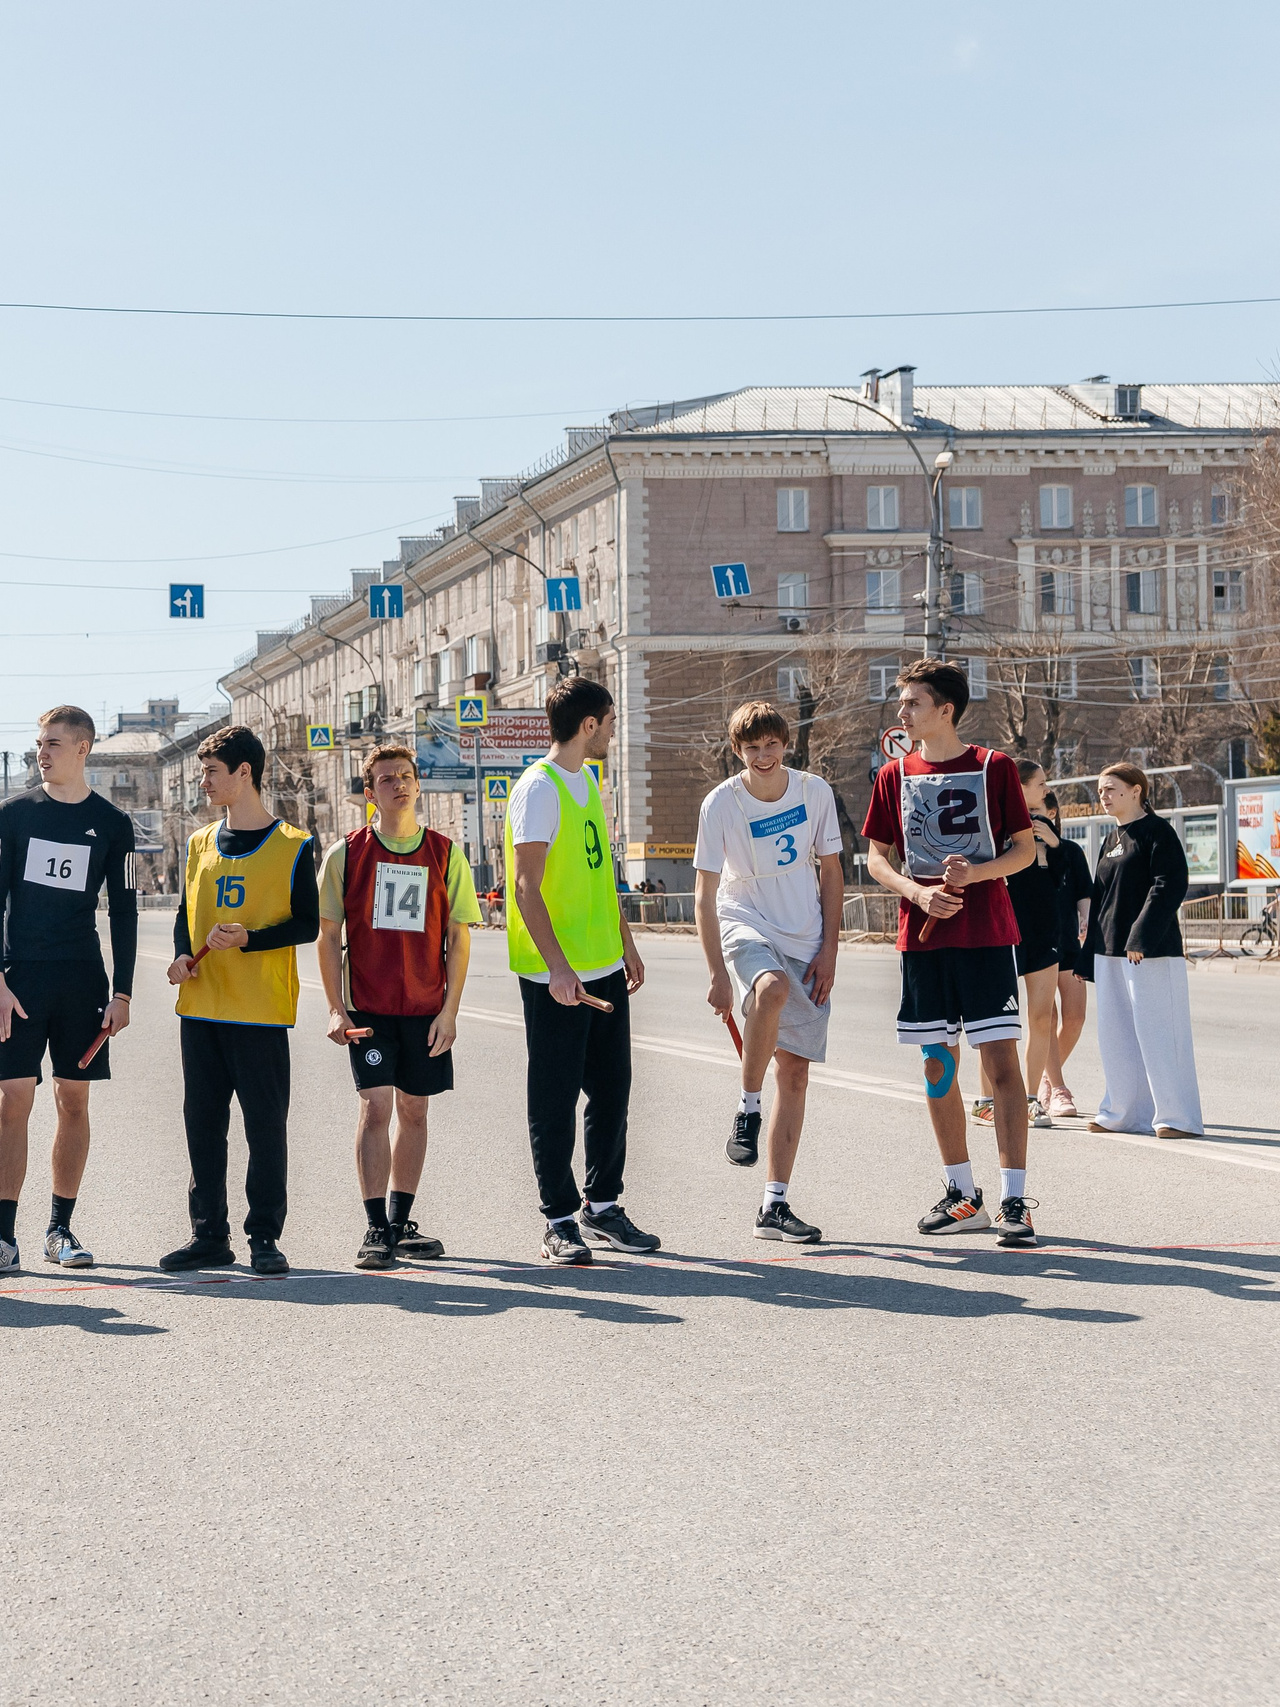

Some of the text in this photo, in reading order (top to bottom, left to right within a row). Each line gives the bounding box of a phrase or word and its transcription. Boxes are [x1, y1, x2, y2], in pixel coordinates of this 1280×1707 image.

[760, 810, 800, 829] ИНЖЕНЕРНЫЙ
[937, 789, 981, 836] 2
[584, 819, 604, 870] 9
[764, 823, 785, 835] ЛИЦЕЙ
[775, 834, 798, 866] 3
[45, 857, 72, 879] 16
[386, 867, 423, 877] Гимназия
[215, 875, 246, 909] 15
[384, 881, 422, 920] 14
